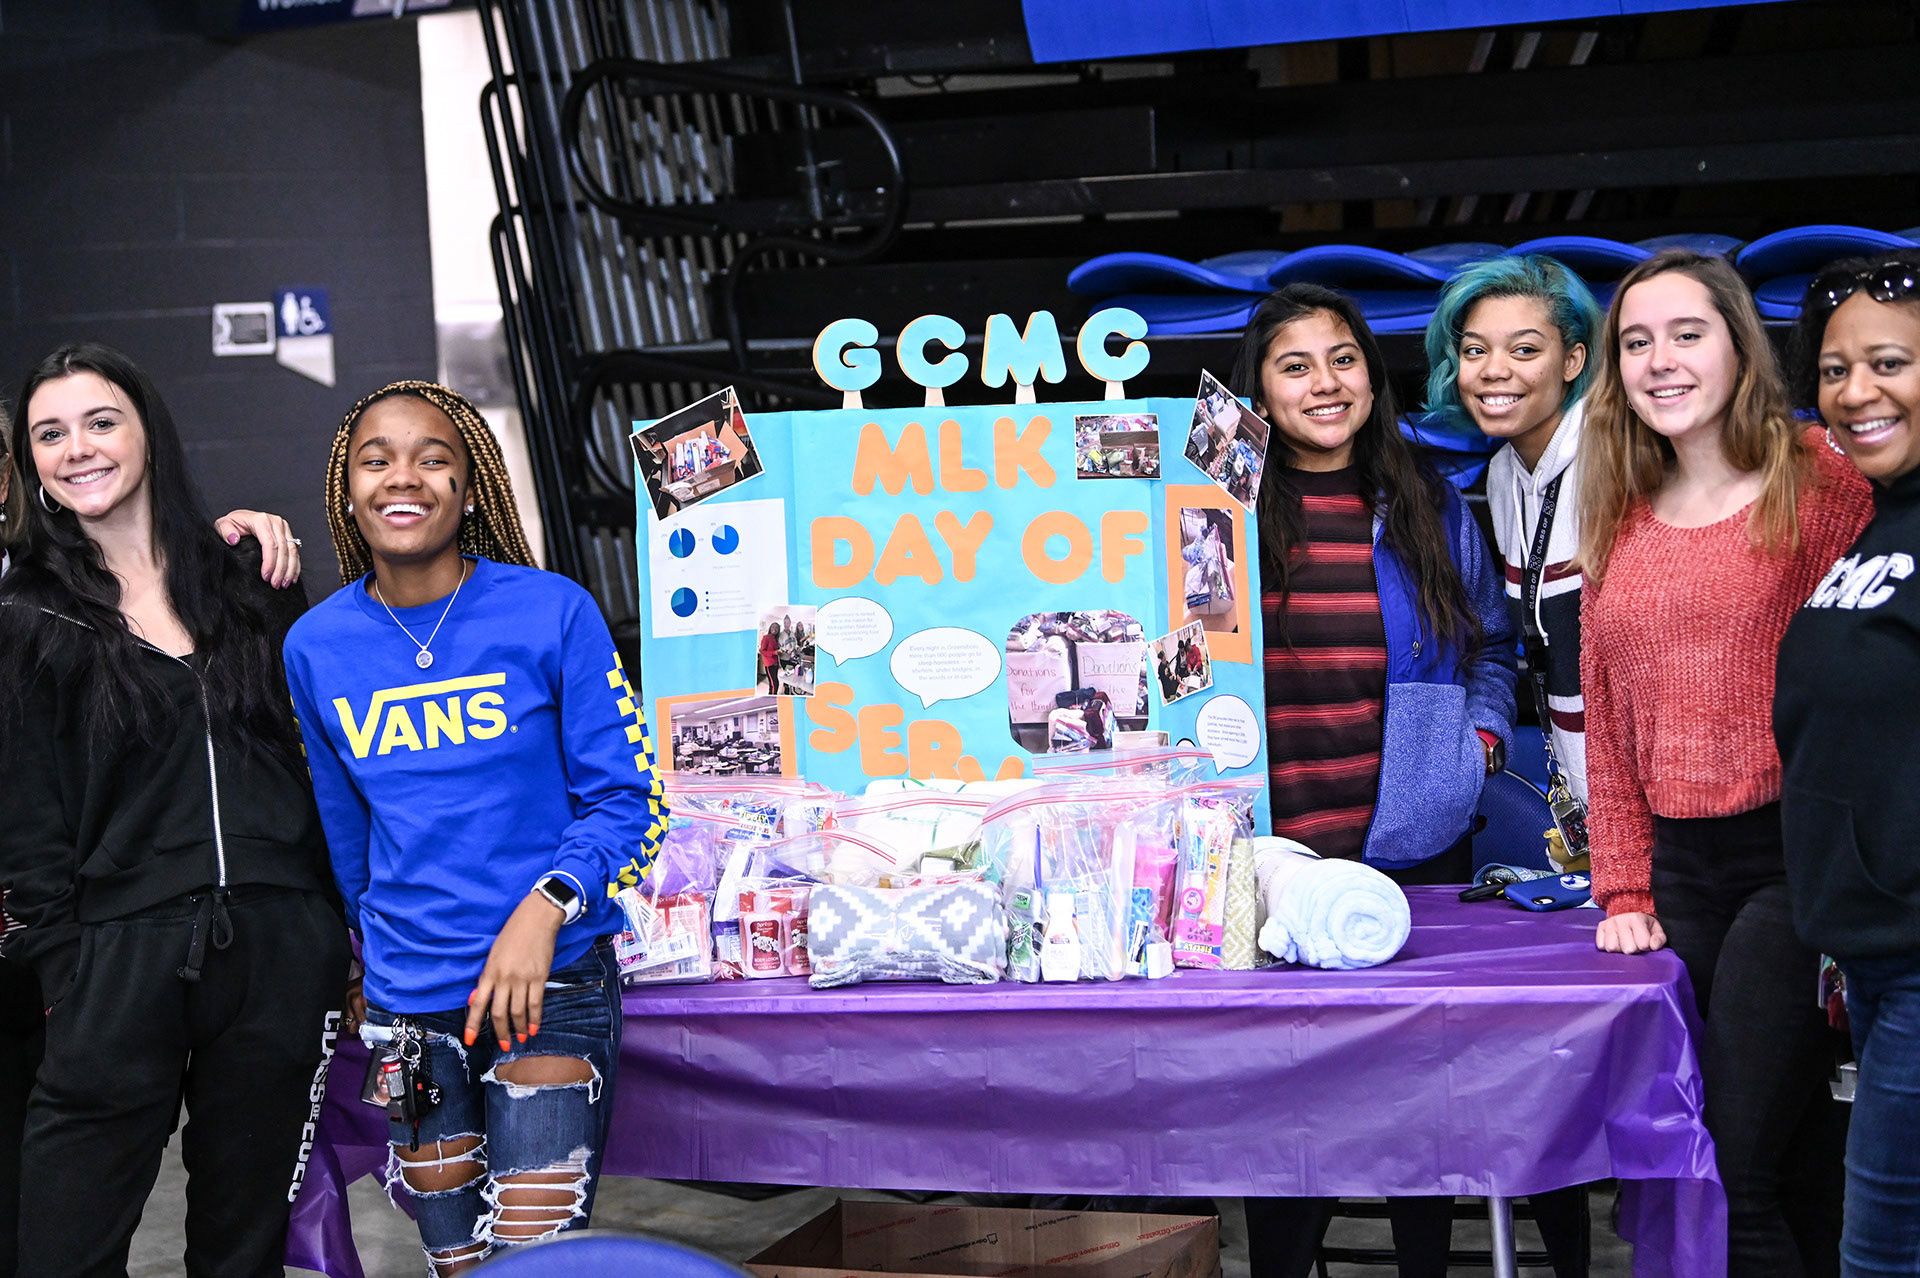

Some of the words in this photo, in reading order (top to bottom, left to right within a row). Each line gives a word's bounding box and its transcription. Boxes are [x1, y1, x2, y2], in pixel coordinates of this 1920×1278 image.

[813, 307, 1150, 391] GCMC
[852, 415, 1057, 496] MLK
[810, 510, 994, 589] DAY
[1021, 510, 1149, 584] OF
[1531, 573, 1537, 584] OF
[1537, 530, 1546, 554] CLASS
[1542, 517, 1548, 529] OF
[1006, 664, 1057, 677] Donations
[1083, 655, 1138, 675] Donations
[1021, 682, 1036, 696] for
[1108, 684, 1126, 694] the
[332, 672, 507, 759] VANS
[309, 1103, 321, 1121] OF
[1099, 1240, 1120, 1251] Office
